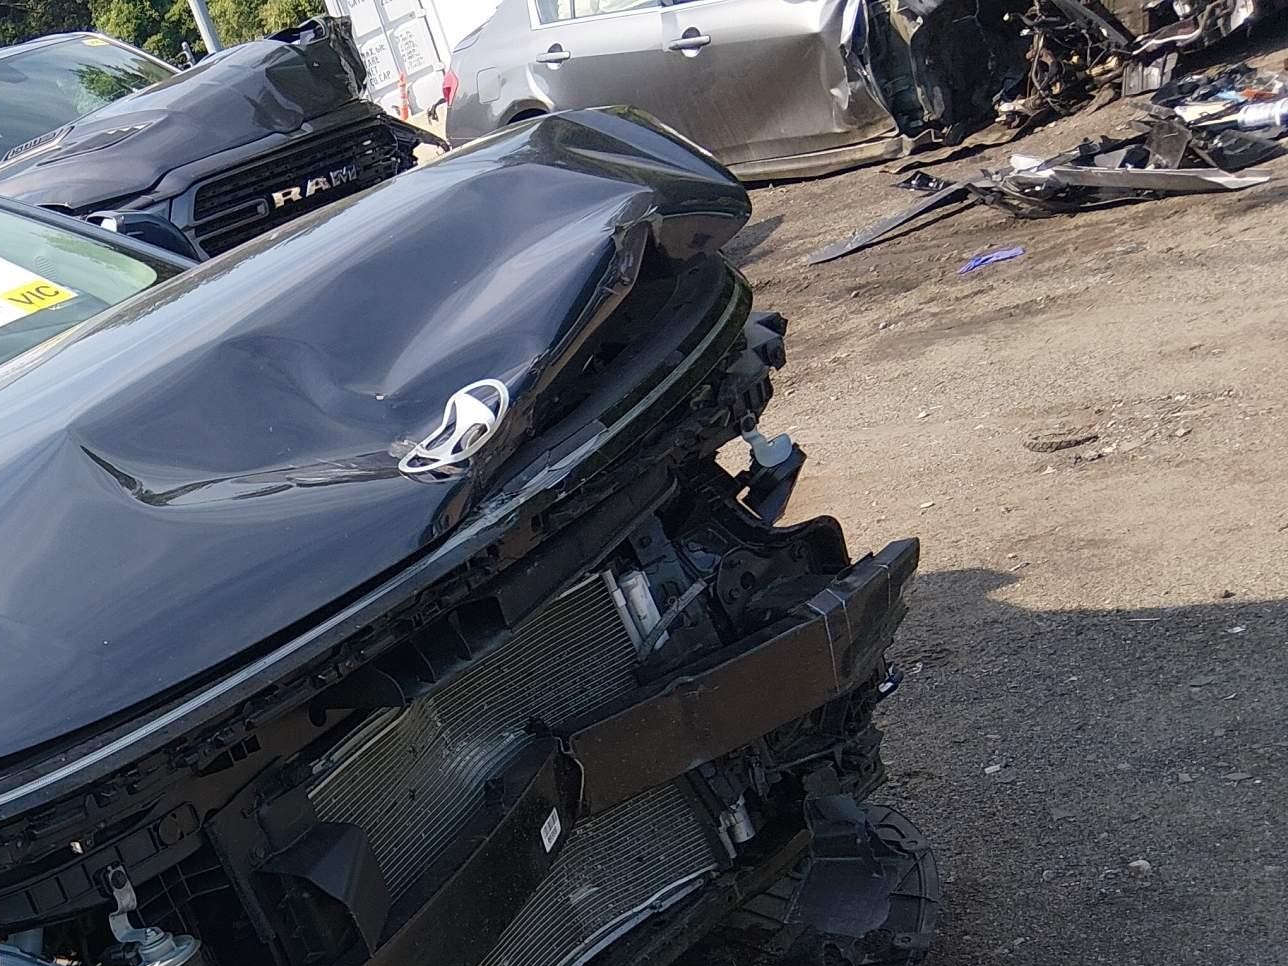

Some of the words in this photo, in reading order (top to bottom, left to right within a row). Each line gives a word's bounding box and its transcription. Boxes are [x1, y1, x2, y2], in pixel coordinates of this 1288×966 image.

[378, 70, 391, 82] CAP
[272, 164, 357, 209] RAM
[8, 285, 60, 307] VIC
